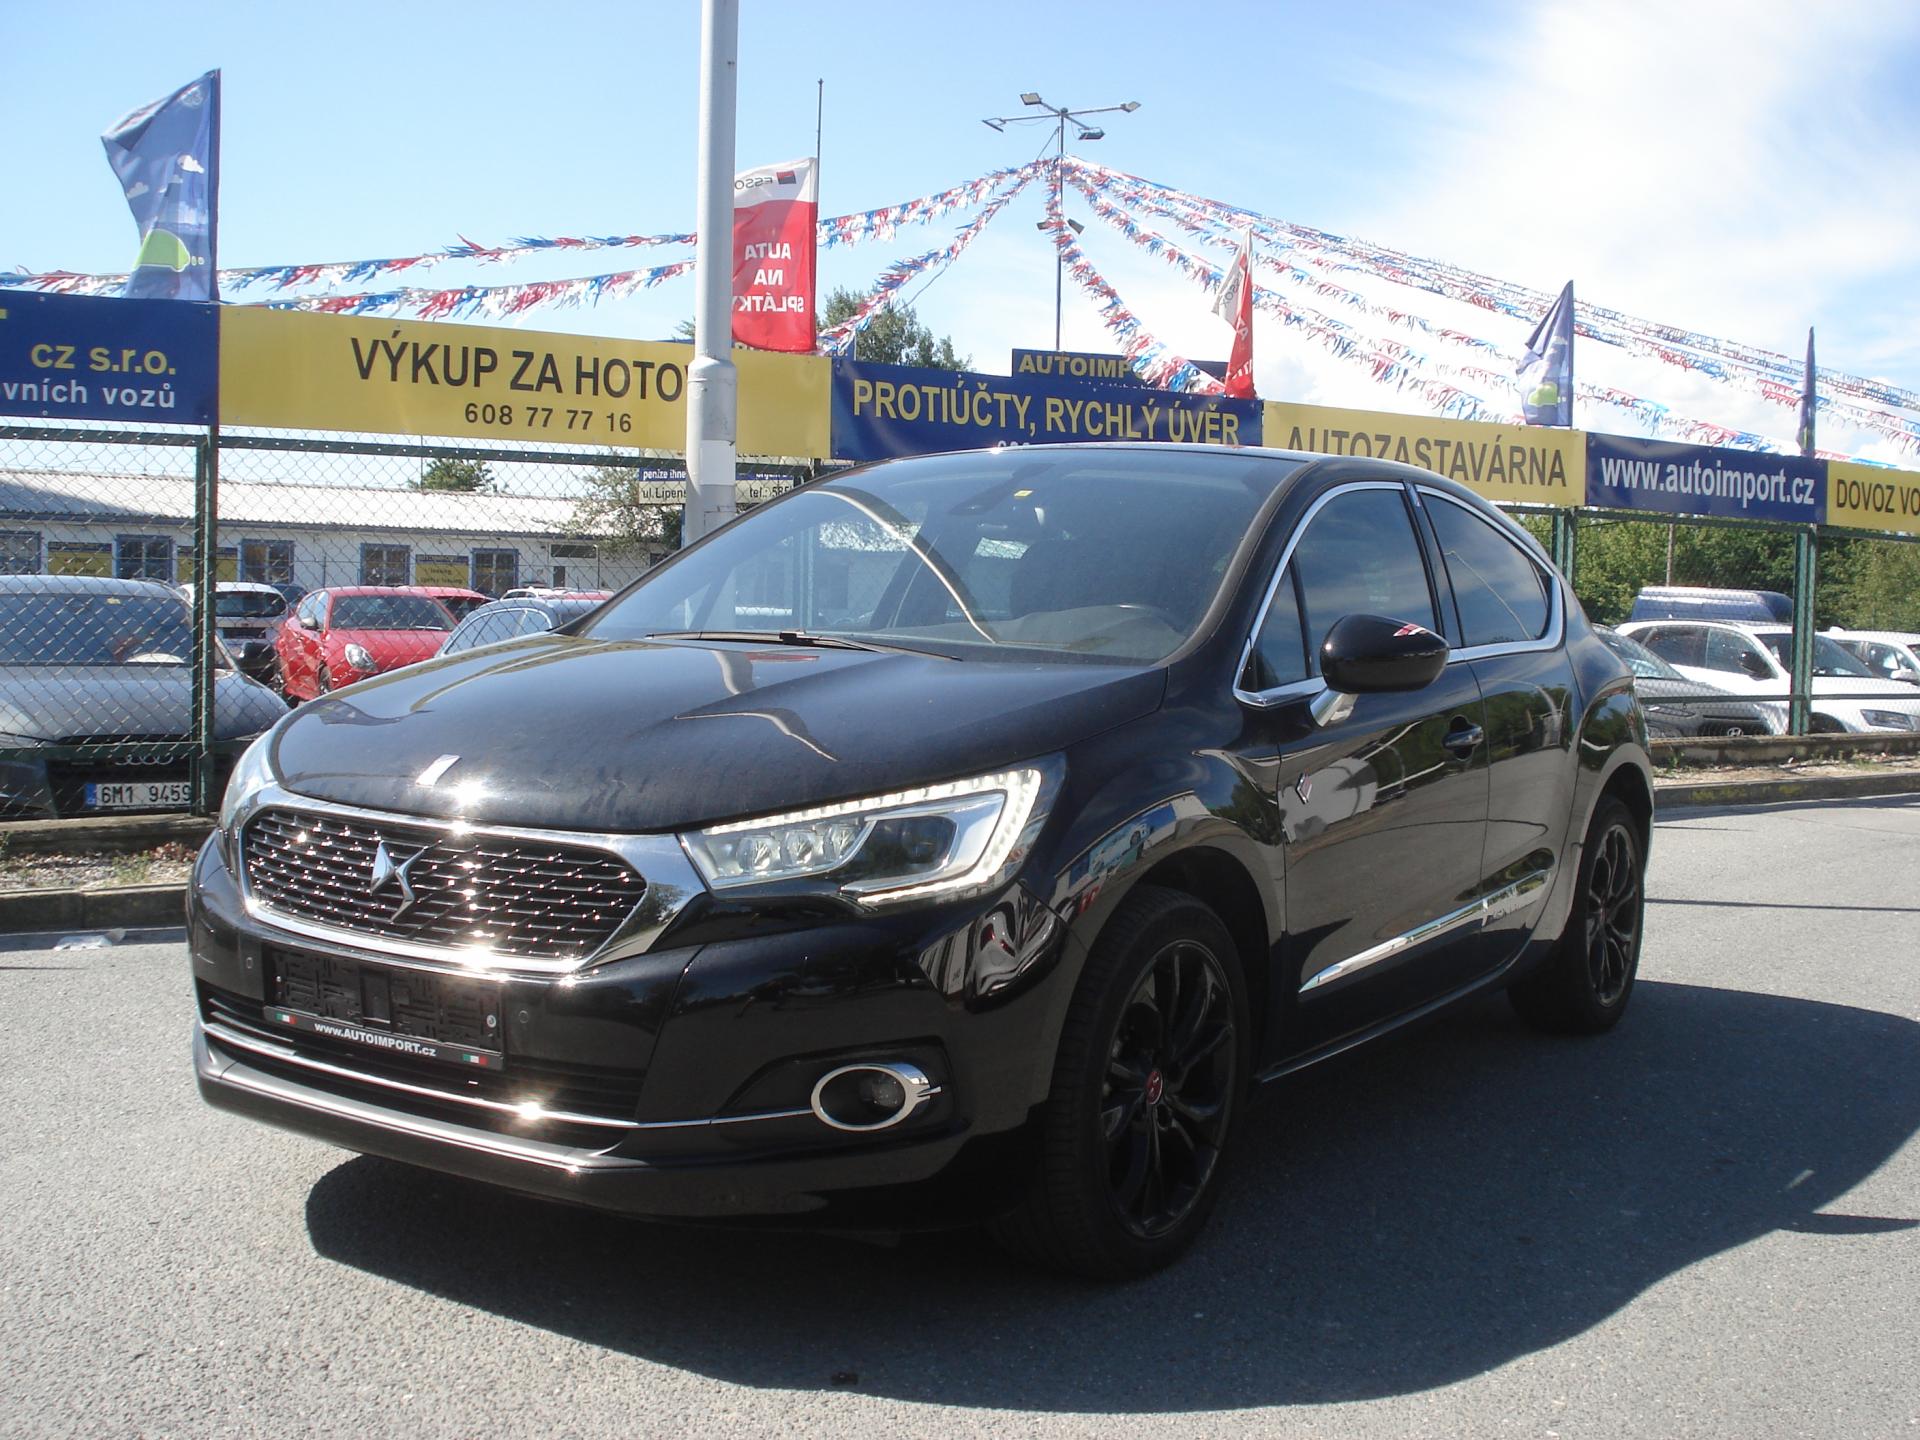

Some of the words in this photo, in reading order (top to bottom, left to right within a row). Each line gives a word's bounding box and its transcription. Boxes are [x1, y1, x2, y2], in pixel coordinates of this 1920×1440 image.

[31, 344, 76, 369] cz
[89, 347, 176, 375] s.r.o.
[351, 331, 498, 387] VÝKUP
[510, 350, 563, 394] ZA
[576, 355, 688, 402] HOTO
[0, 377, 87, 404] vních
[102, 382, 175, 408] vozů
[465, 403, 513, 426] 608
[526, 406, 553, 428] 77
[566, 409, 593, 431] 77
[606, 412, 632, 433] 16
[852, 379, 1036, 438] PROTIÚČTY,
[1046, 398, 1159, 440] RYCHLÝ
[1168, 401, 1240, 445] ÚVĚR
[1288, 426, 1567, 487] AUTOZASTAVÁRNA
[1601, 457, 1815, 508] www.autoimport.cz
[1836, 478, 1896, 514] DOVOZ
[101, 786, 134, 804] 6M1
[314, 1021, 437, 1058] www.AUTOIMPORT.cz
